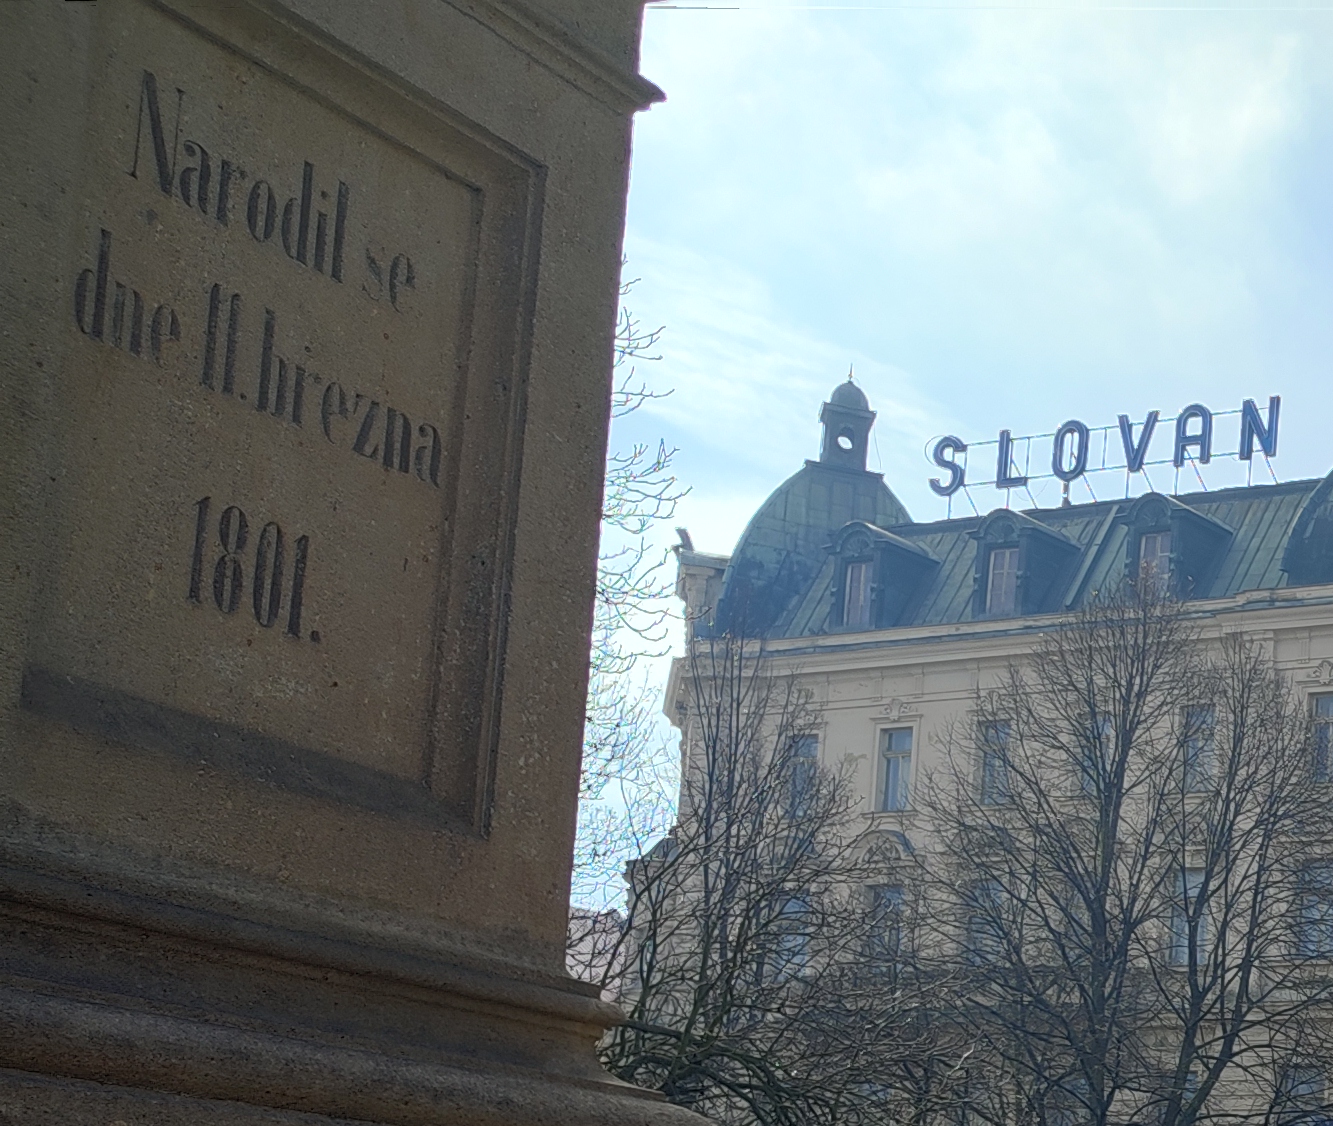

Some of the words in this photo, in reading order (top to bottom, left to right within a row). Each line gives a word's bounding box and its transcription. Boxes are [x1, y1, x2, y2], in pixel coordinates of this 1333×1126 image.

[127, 68, 351, 284] Narodil
[361, 246, 417, 314] se
[74, 228, 181, 368] dne
[928, 395, 1282, 497] SLOVAN
[187, 496, 322, 643] 1801.
